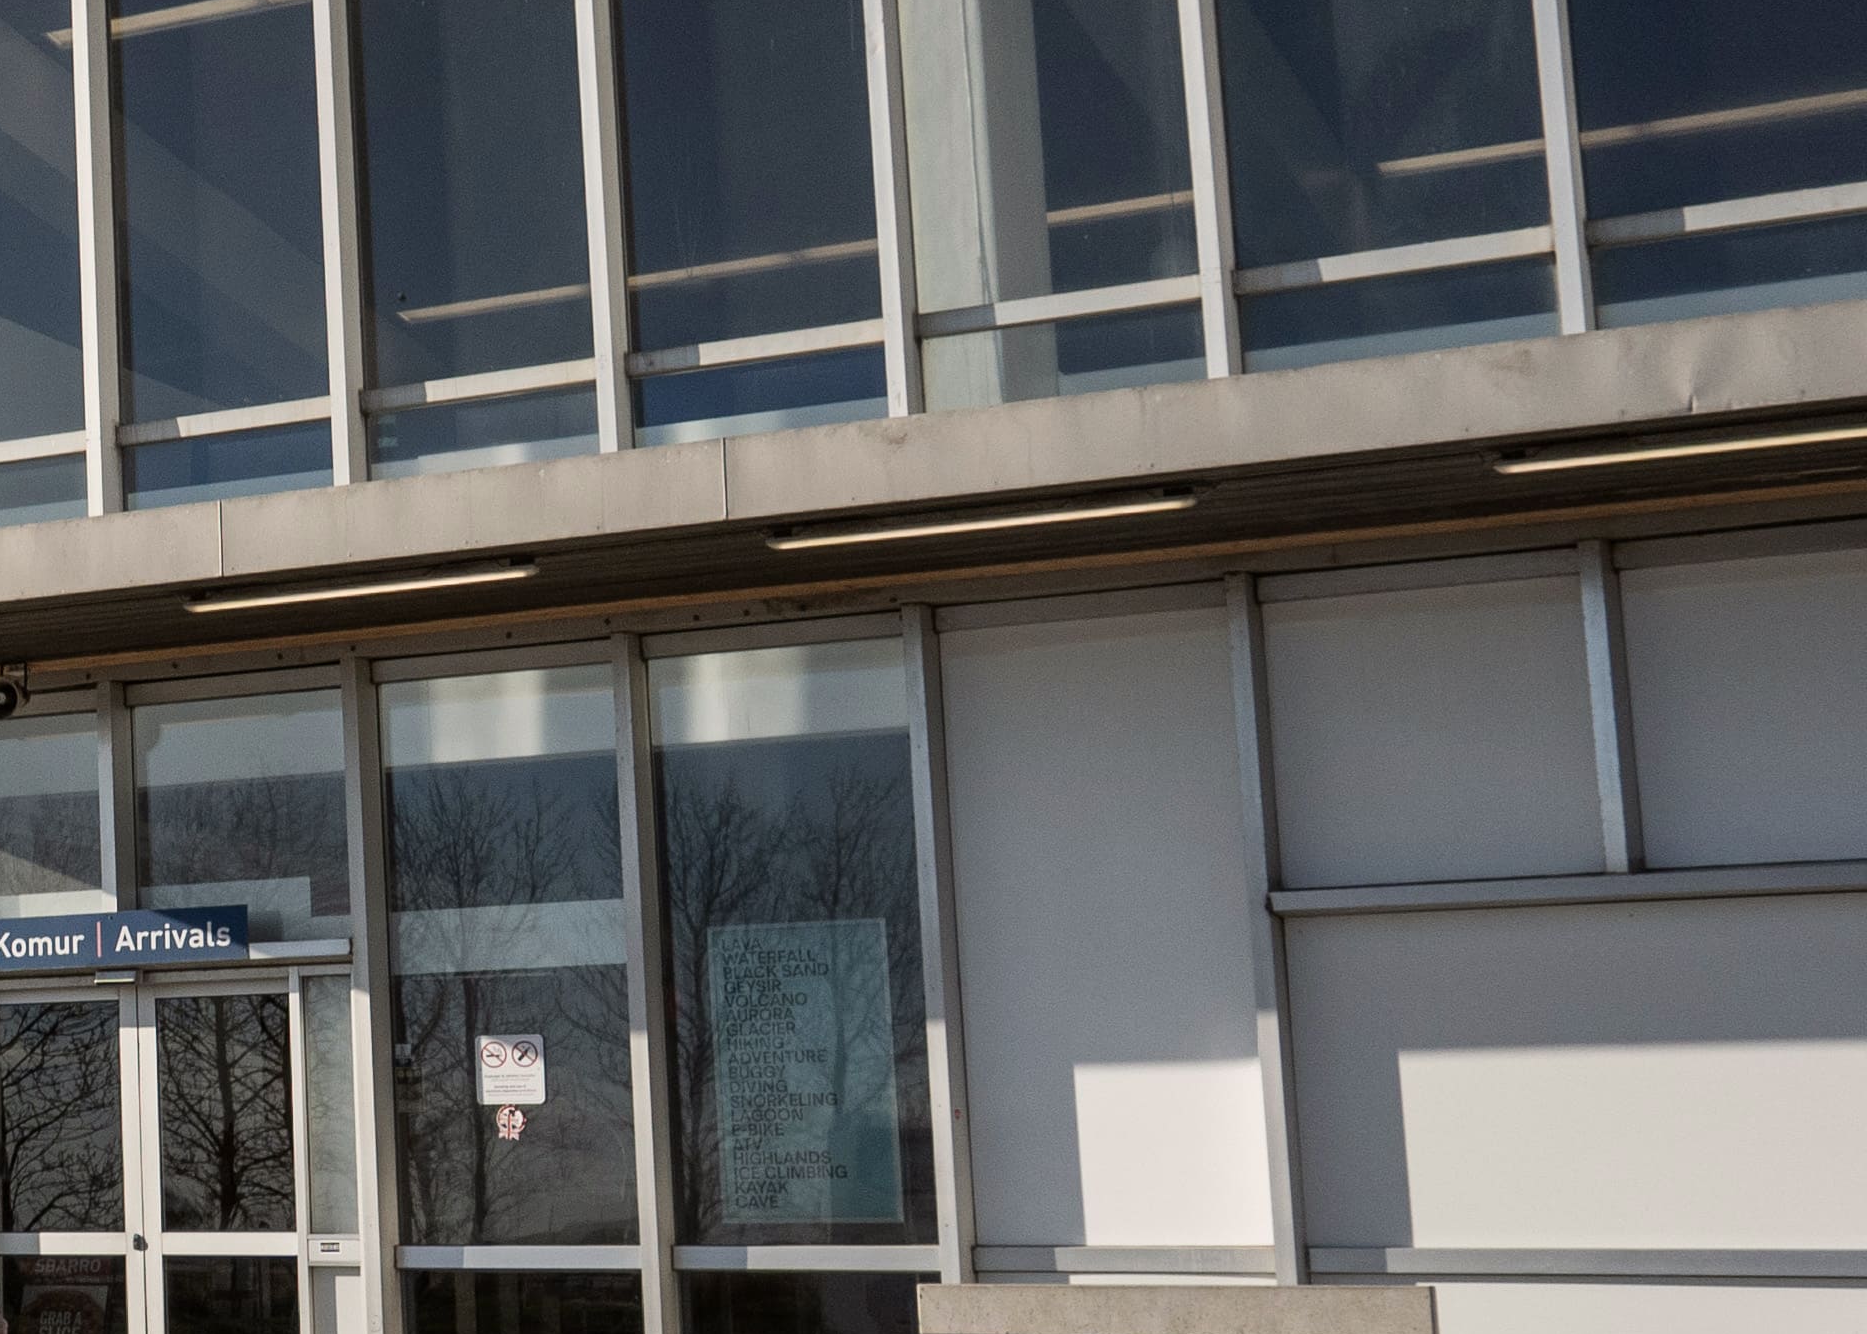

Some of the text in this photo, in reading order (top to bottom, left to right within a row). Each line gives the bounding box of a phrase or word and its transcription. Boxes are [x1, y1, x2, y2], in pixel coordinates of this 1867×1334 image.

[115, 921, 231, 952] Arrivals
[722, 938, 762, 951] LAVA
[723, 950, 816, 965] WATERFALL
[723, 962, 829, 980] BLACK SAND
[724, 979, 782, 994] GEYSIR
[725, 992, 808, 1008] VOLCANO
[726, 1007, 795, 1022] AURORA
[727, 1021, 796, 1037] GLACIER
[727, 1036, 784, 1051] HIKING
[729, 1049, 828, 1065] ADVENTURE
[729, 1064, 786, 1079] BUGGY
[730, 1079, 788, 1094] DIVING
[730, 1092, 838, 1108] SNORKELING
[731, 1107, 803, 1122] LAGOON
[732, 1122, 785, 1137] E-BIKE
[733, 1137, 763, 1151] ATV
[734, 1150, 832, 1165] HIGHLANDS
[734, 1164, 848, 1180] ICE CLIMBING
[735, 1180, 789, 1195] KAYAK
[736, 1194, 780, 1209] CAVE
[34, 1258, 102, 1274] SBARRO
[40, 1311, 83, 1325] GRAB A
